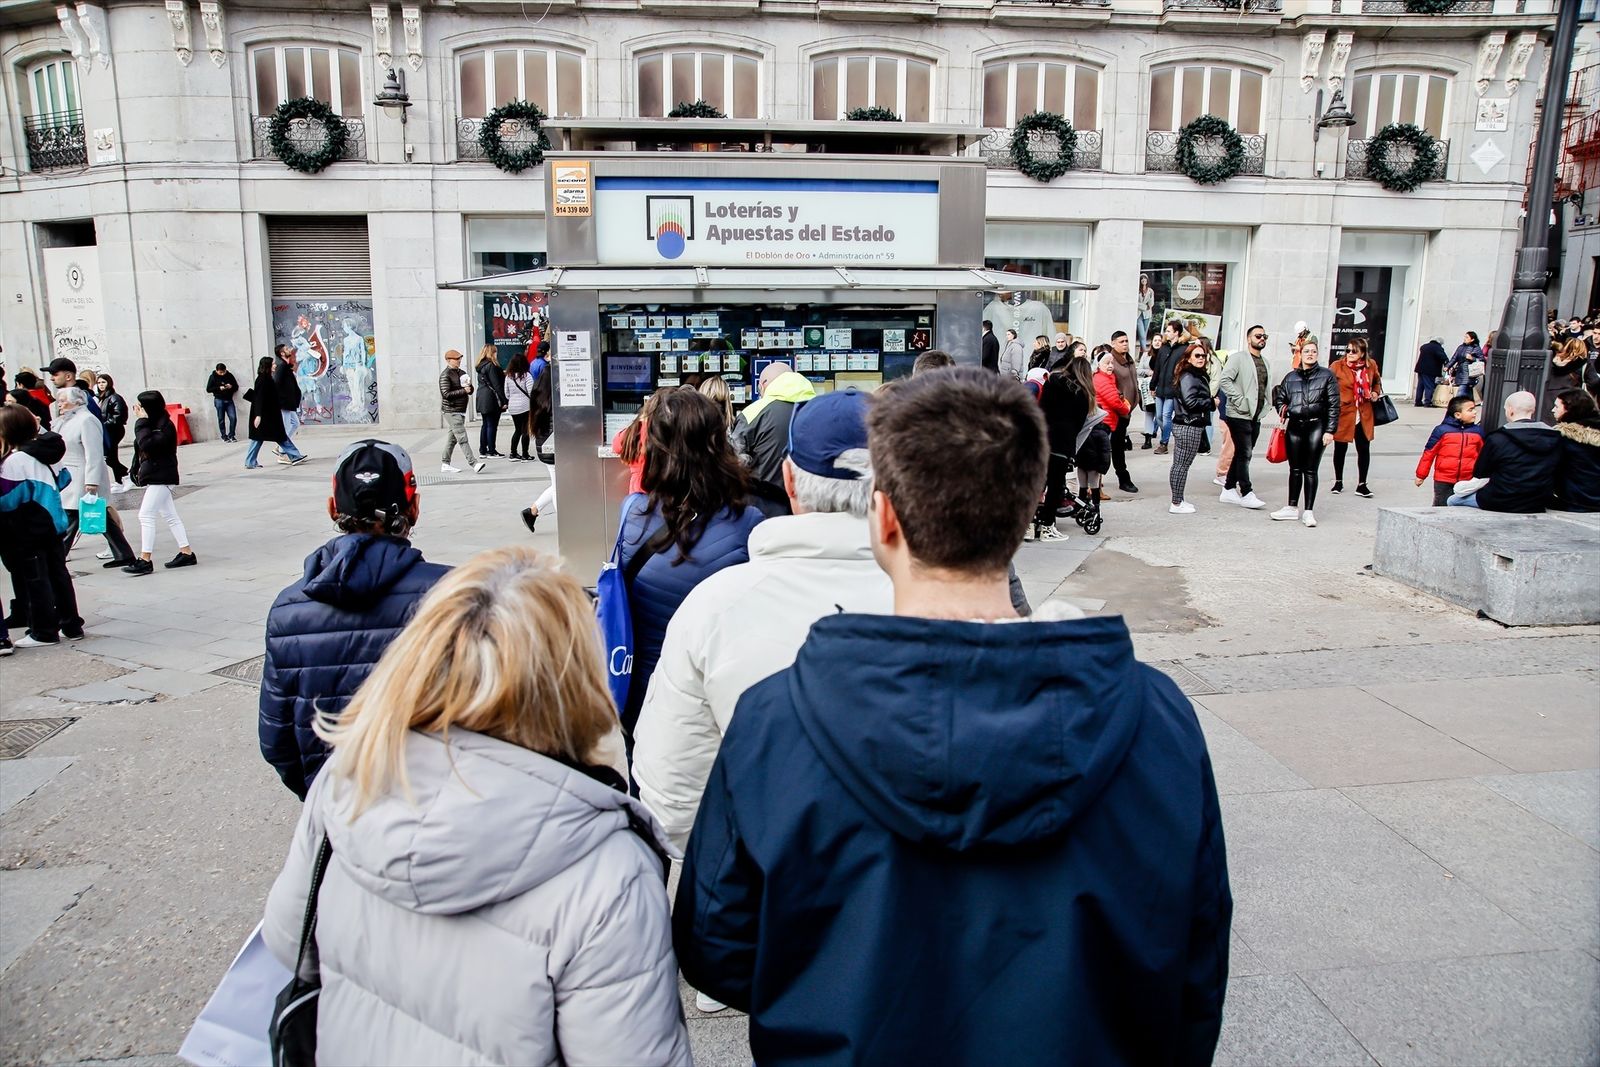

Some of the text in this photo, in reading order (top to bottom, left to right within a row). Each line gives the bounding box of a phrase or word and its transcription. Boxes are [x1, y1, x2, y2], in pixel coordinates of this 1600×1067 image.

[705, 201, 798, 222] Loterías y
[706, 224, 895, 244] Apuestas del Estado
[754, 251, 782, 260] Doblón
[784, 252, 794, 260] de
[818, 252, 874, 260] Administración
[72, 270, 78, 286] 9
[828, 334, 840, 348] 15
